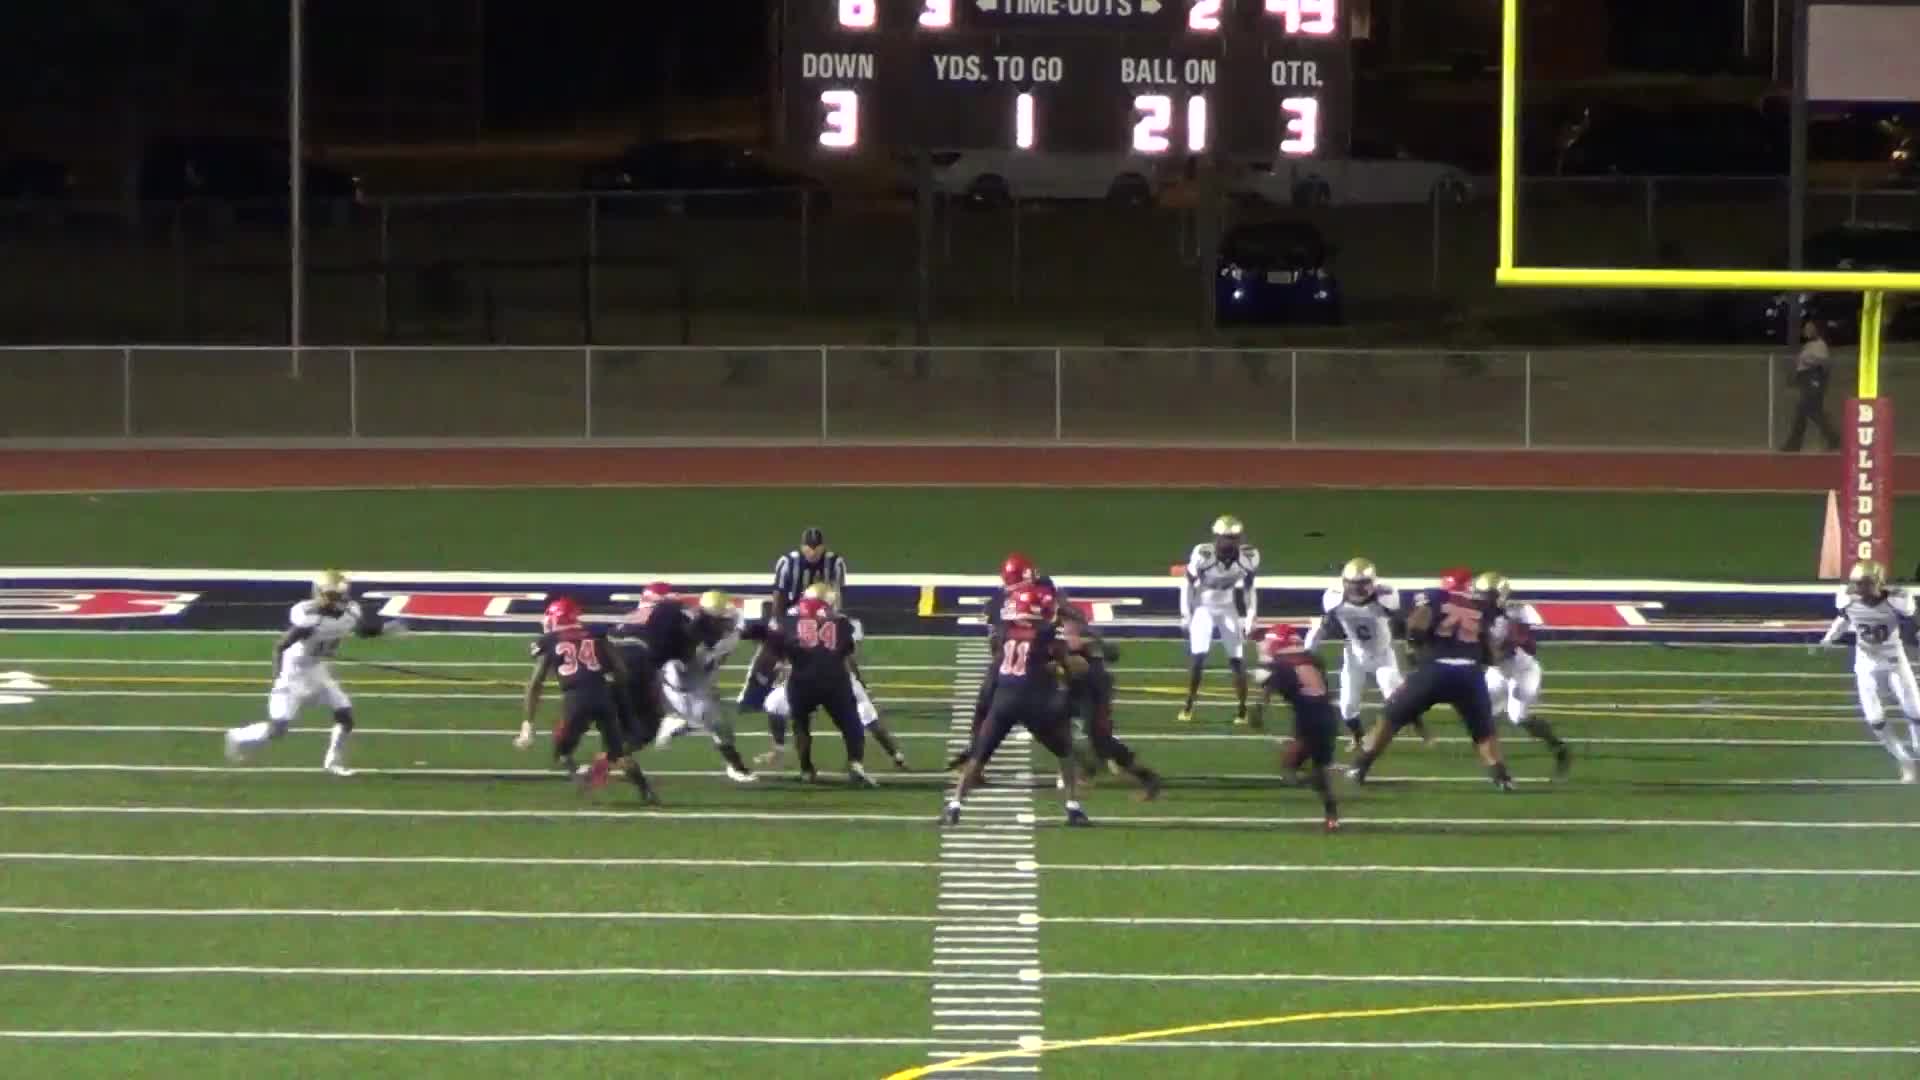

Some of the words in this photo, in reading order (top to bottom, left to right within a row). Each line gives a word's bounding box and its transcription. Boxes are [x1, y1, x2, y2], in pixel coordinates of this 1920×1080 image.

[802, 53, 874, 79] DOWN
[933, 55, 988, 81] YDS.
[995, 55, 1025, 81] TO
[1031, 56, 1063, 82] GO
[1121, 58, 1177, 84] BALL
[1184, 60, 1216, 85] ON
[1271, 60, 1324, 87] QTR.
[819, 90, 858, 148] 3
[1016, 93, 1034, 149] 1
[1132, 95, 1207, 153] 21
[1280, 97, 1319, 154] 3
[555, 639, 601, 675] 34
